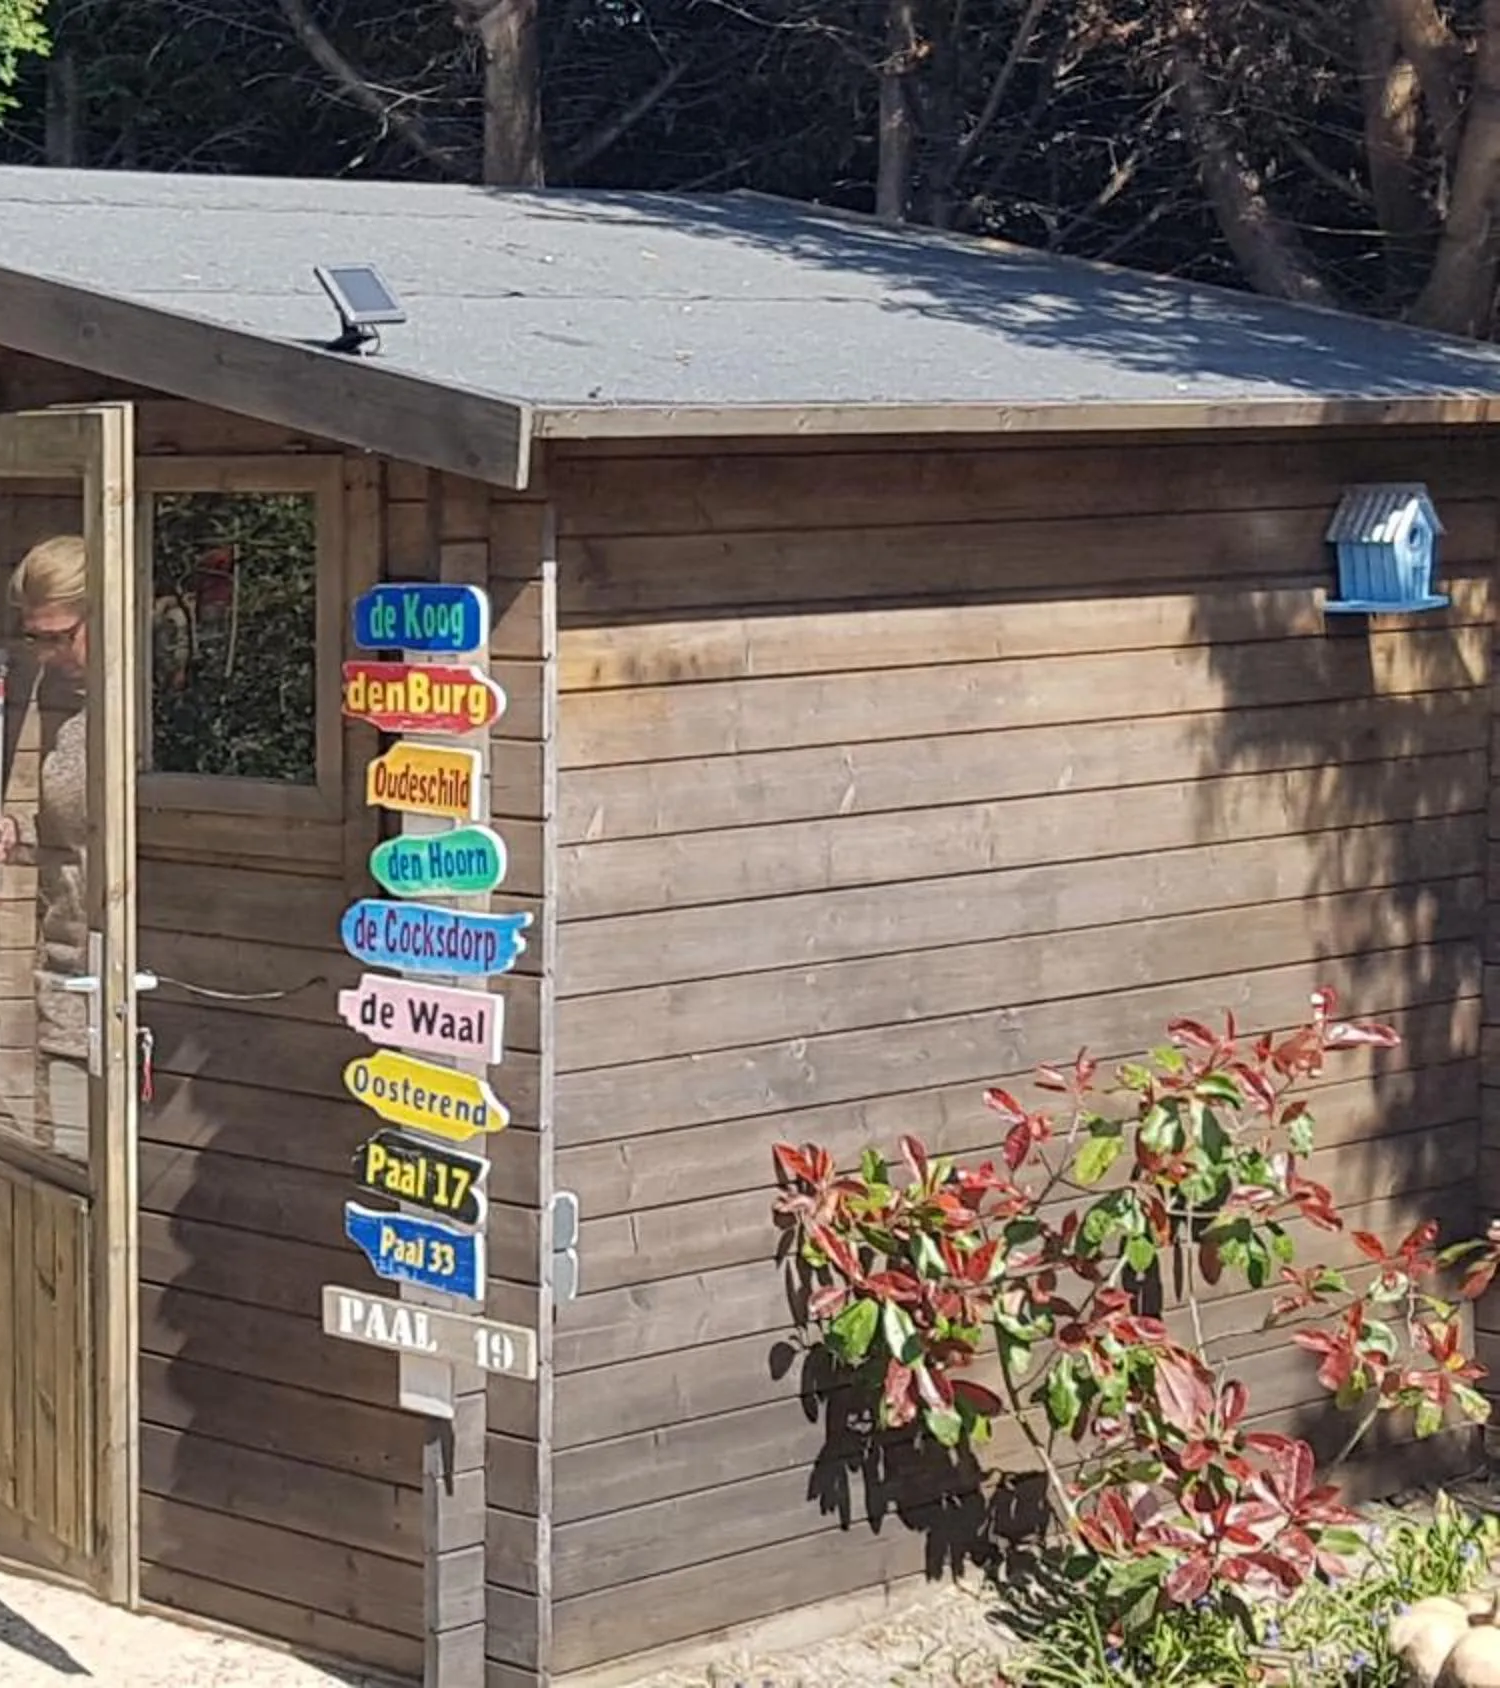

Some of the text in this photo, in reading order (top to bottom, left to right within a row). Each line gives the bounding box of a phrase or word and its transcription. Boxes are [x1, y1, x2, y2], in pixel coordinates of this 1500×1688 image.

[370, 593, 465, 646] de Koog
[374, 761, 470, 809] Oudeschild
[388, 842, 489, 881] den Hoorn
[353, 906, 497, 970] de Cocksdorp
[359, 993, 485, 1044] de Waal
[353, 1065, 488, 1127] Oosterend
[365, 1144, 471, 1209] Paal 17
[379, 1226, 456, 1276] Paal 33
[338, 1295, 514, 1371] PAAL 19
